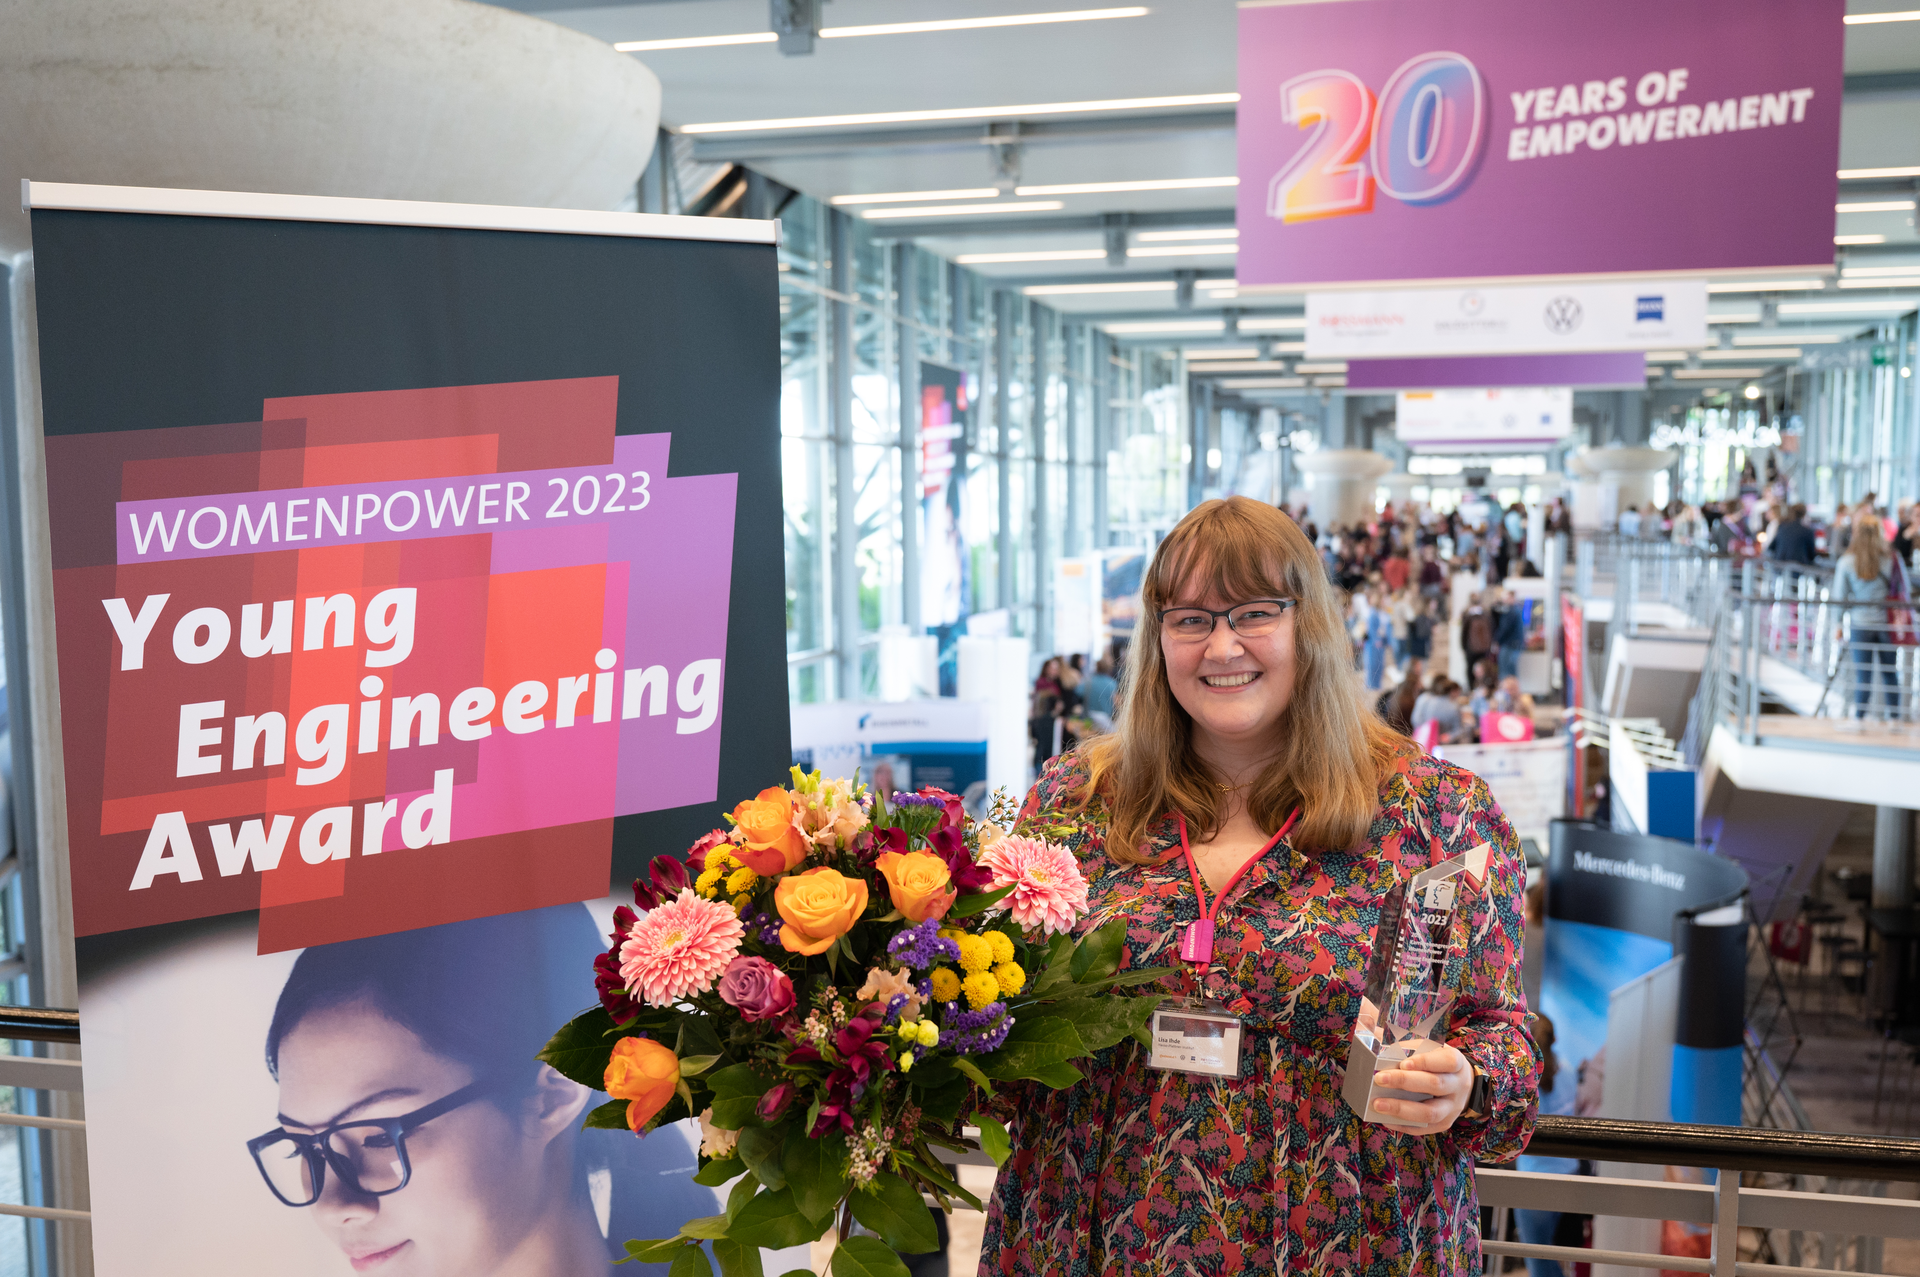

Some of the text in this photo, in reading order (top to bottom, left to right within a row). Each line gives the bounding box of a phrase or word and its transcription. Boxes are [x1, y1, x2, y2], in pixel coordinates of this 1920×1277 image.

[1266, 50, 1487, 225] 20
[1506, 86, 1815, 162] EMPOWERMENT
[1510, 67, 1689, 124] YEARS OF
[129, 469, 652, 556] WOMENPOWER 2023
[102, 587, 418, 672] Young
[175, 648, 723, 787] Engineering
[128, 767, 456, 892] Award
[1420, 912, 1448, 926] 2023
